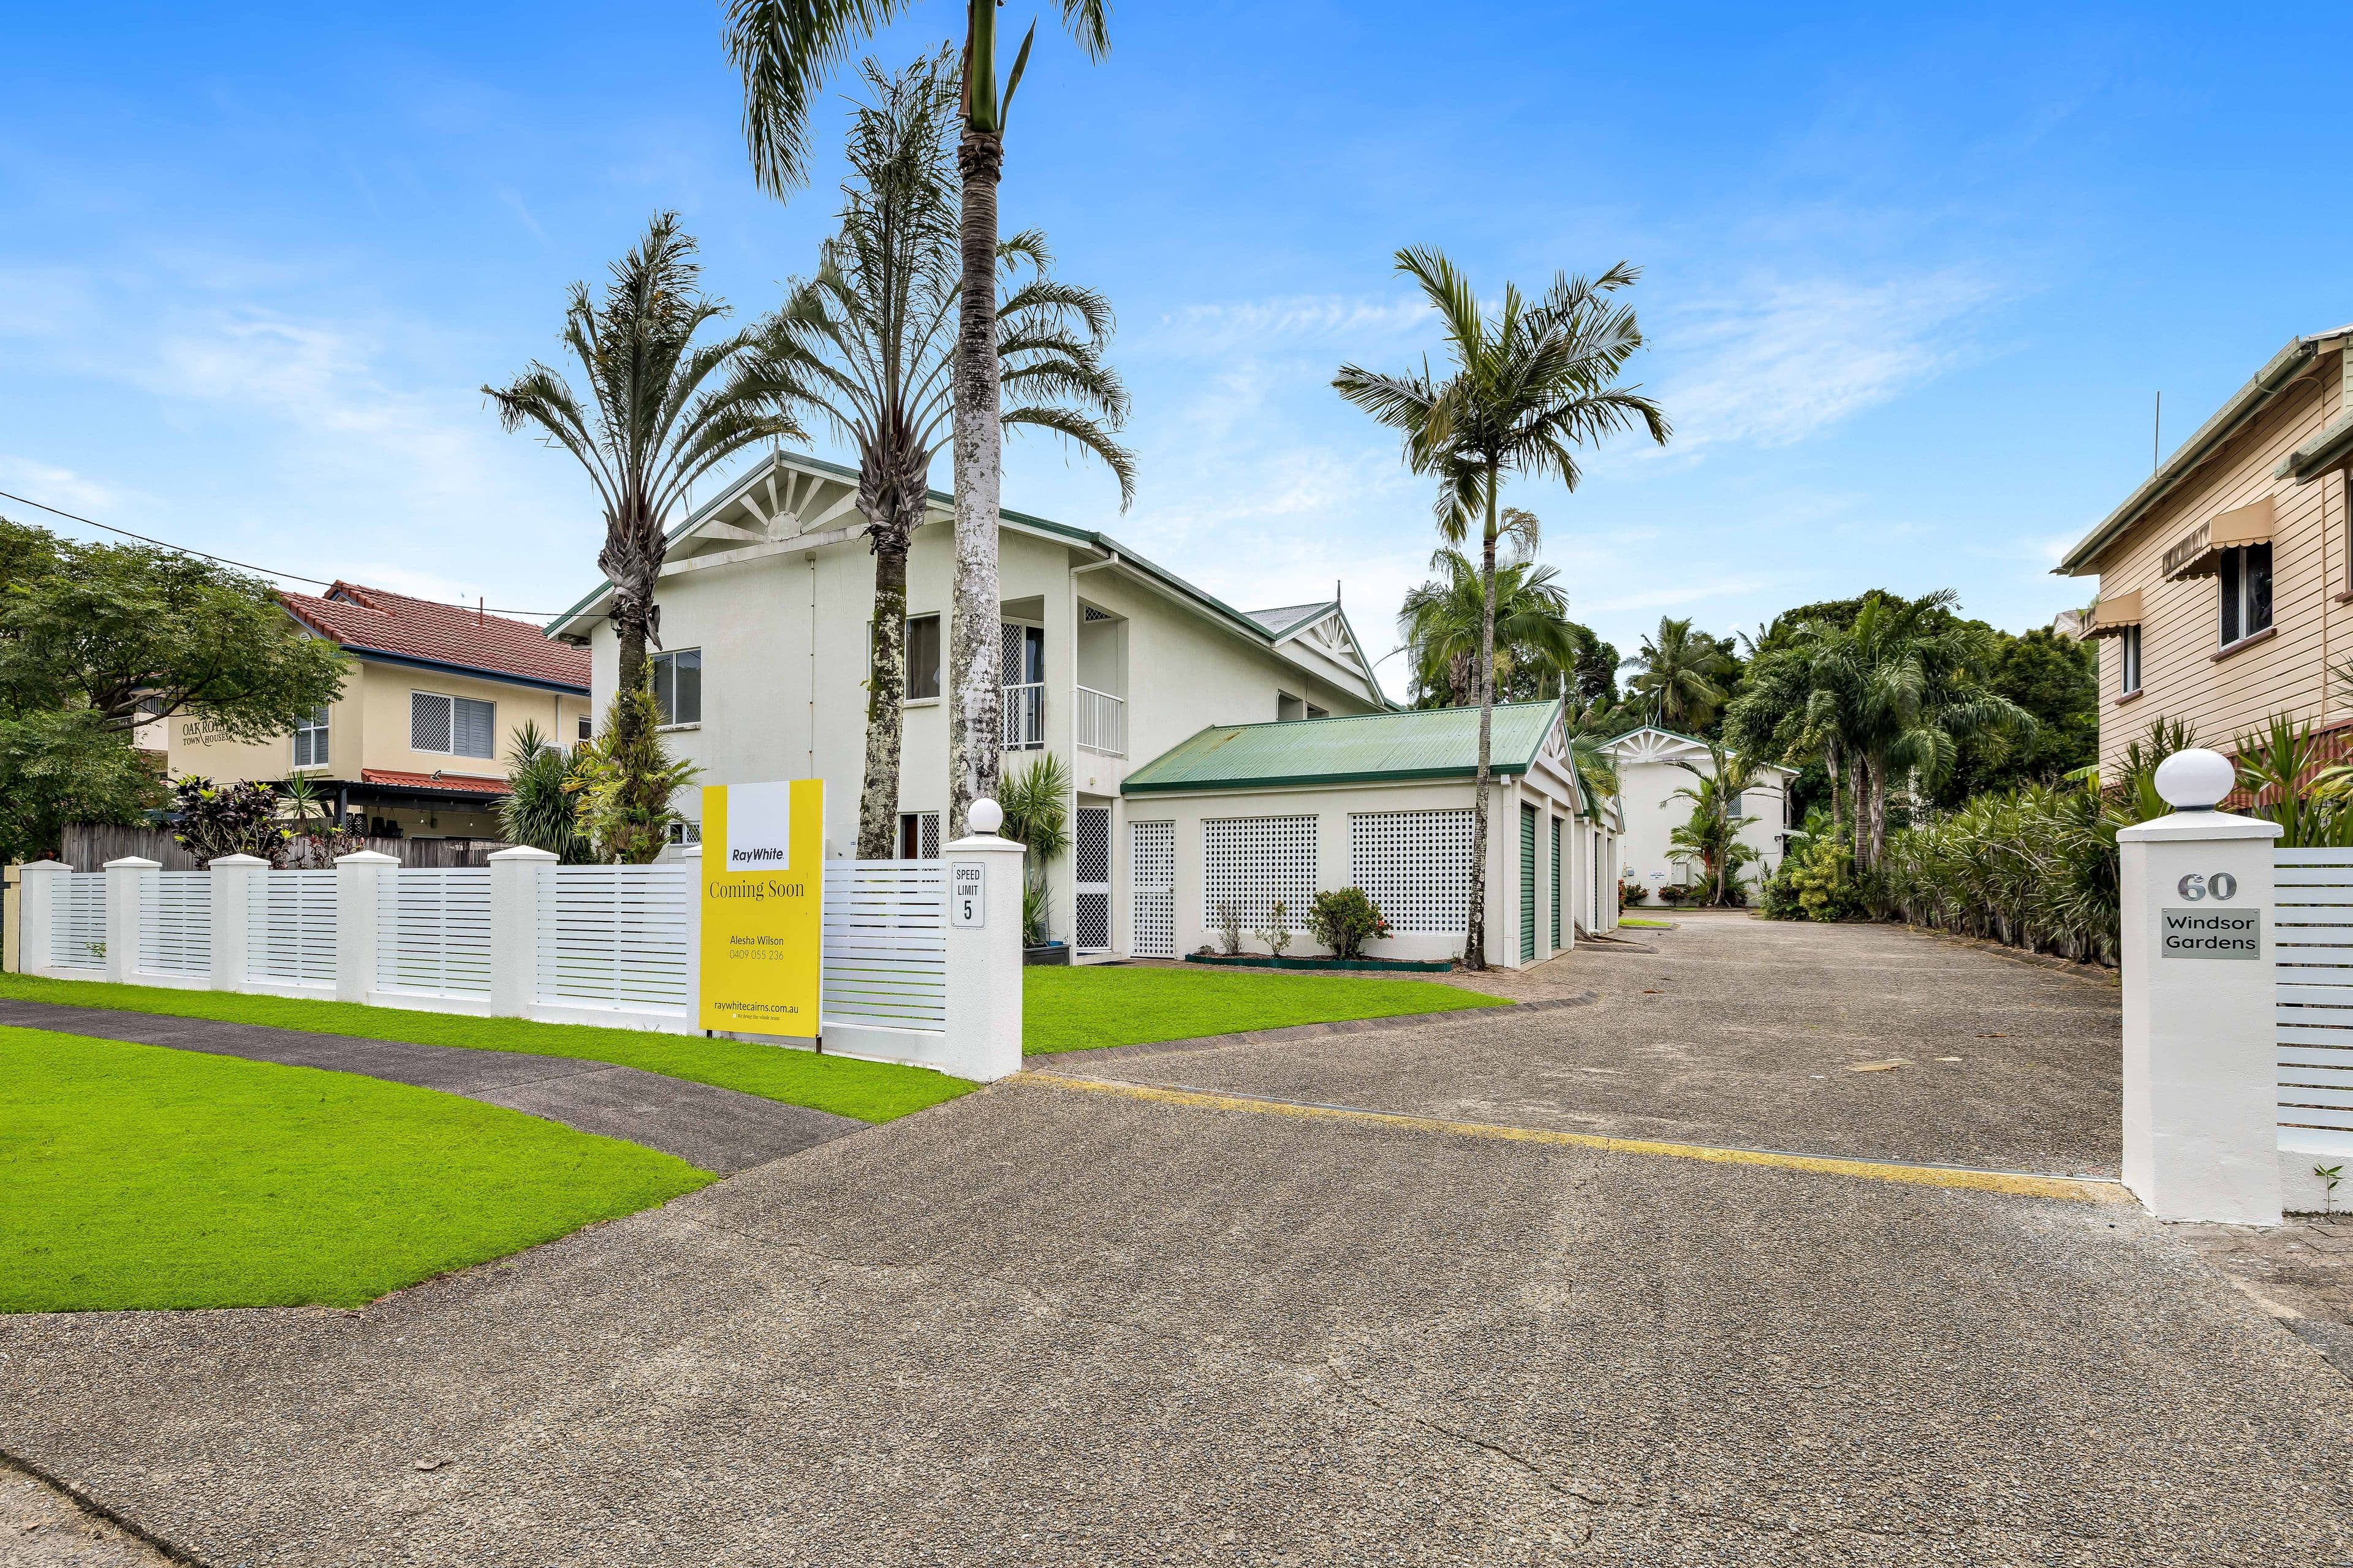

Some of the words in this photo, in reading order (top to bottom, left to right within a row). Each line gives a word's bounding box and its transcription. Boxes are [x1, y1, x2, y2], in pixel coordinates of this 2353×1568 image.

[183, 737, 200, 745] TOWN
[205, 733, 229, 743] HOUSES
[956, 869, 980, 880] SPEED
[710, 880, 764, 901] Coming
[768, 880, 804, 898] Soon
[958, 885, 978, 895] LIMIT
[2178, 872, 2237, 901] 60
[964, 900, 972, 920] 5
[2167, 916, 2255, 930] Windsor
[730, 936, 755, 944] Alesha
[757, 936, 784, 945] Wilson
[2166, 936, 2256, 950] Gardens
[730, 949, 749, 959] 0409
[751, 950, 766, 960] 055
[769, 950, 784, 960] 236
[714, 1001, 798, 1013] raywhitecairns.com.au
